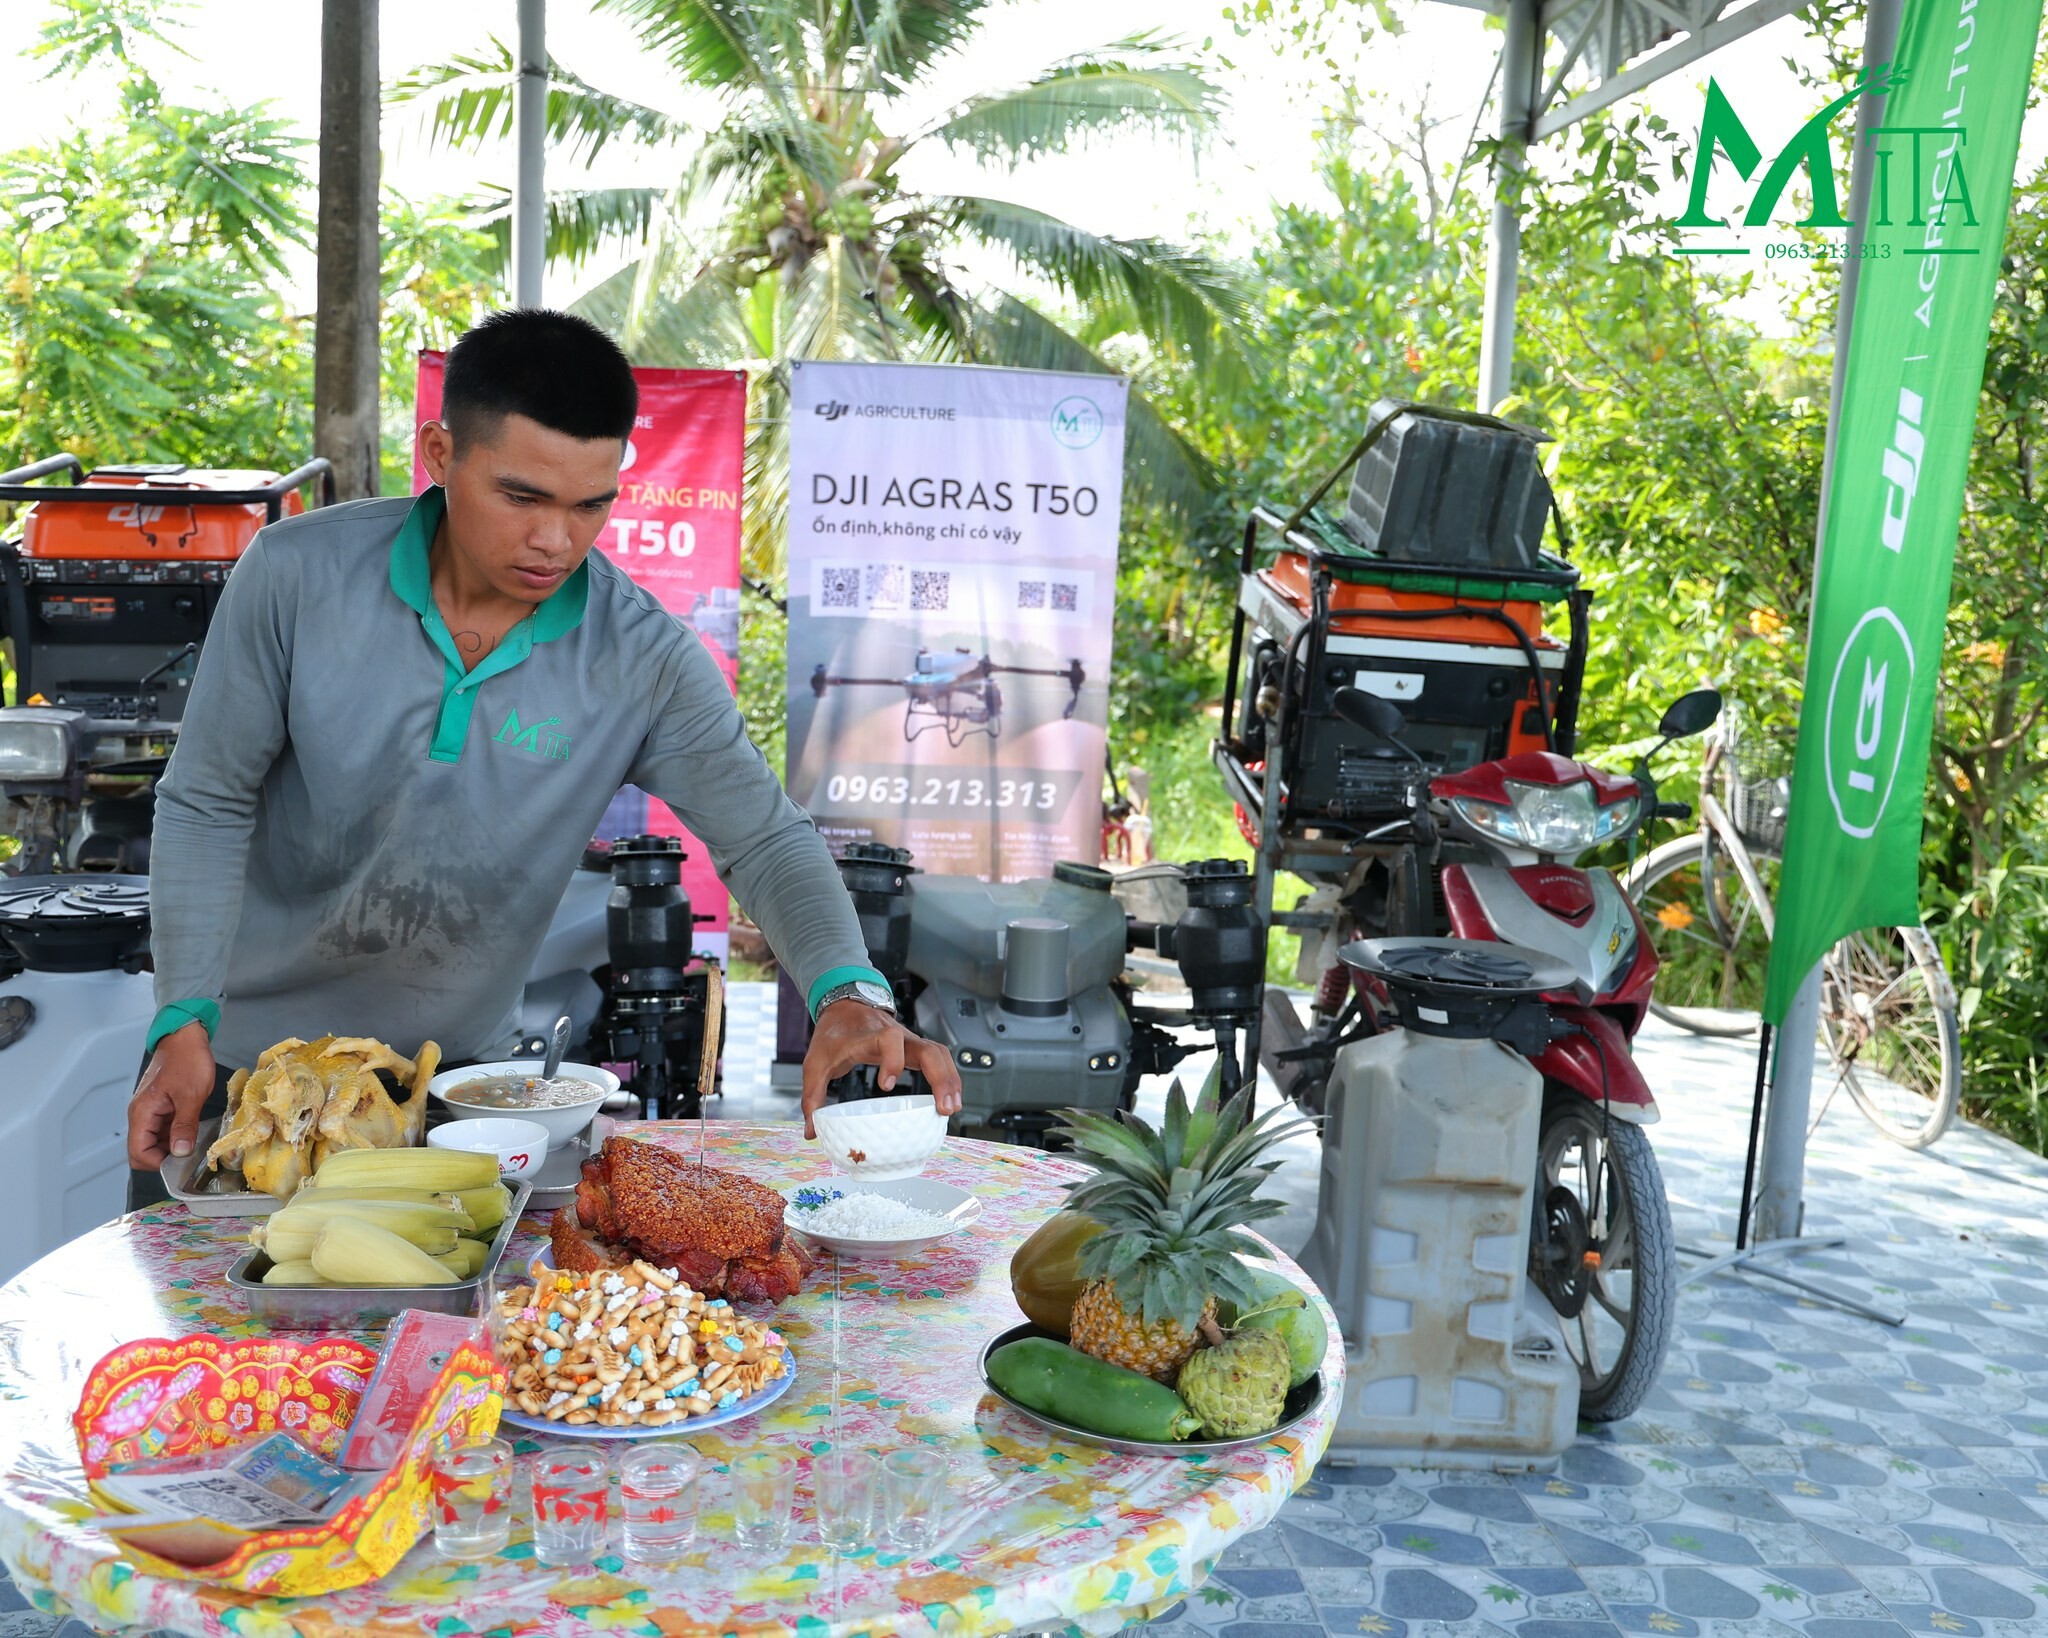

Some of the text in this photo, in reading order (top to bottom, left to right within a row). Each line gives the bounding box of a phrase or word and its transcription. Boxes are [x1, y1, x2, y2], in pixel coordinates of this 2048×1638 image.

[855, 404, 956, 421] AGRICULTURE
[627, 481, 693, 510] TẶNG
[698, 489, 738, 511] PIN
[812, 474, 1098, 517] DJI AGRAS T50
[609, 517, 696, 557] T50
[941, 523, 965, 540] chỉ
[969, 524, 988, 540] có
[993, 527, 1022, 545] vậy
[827, 775, 1058, 809] 0963.213.313
